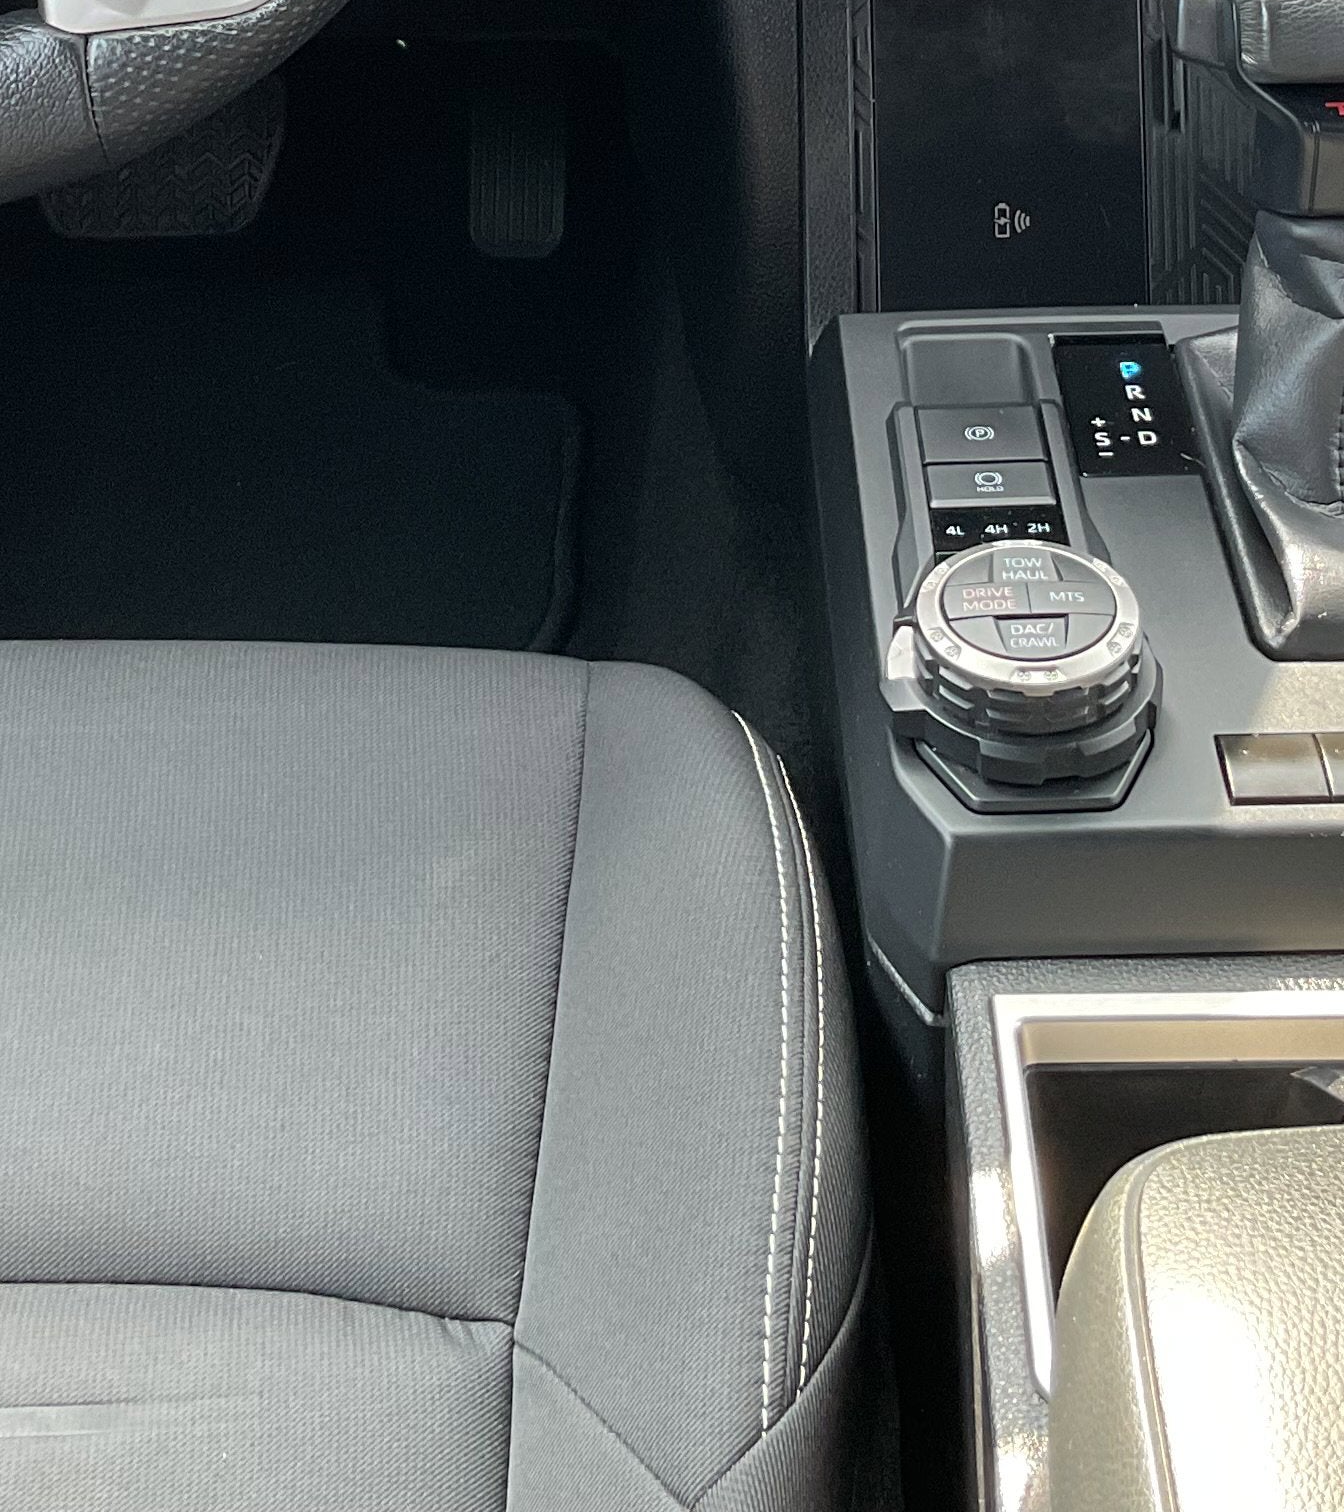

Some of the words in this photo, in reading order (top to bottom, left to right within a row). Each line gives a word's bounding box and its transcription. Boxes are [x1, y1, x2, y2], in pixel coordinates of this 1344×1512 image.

[1118, 360, 1142, 379] P
[1124, 384, 1146, 401] R
[1131, 407, 1153, 422] N
[1093, 431, 1111, 447] S
[1137, 430, 1157, 446] D
[945, 525, 966, 536] 4L
[984, 523, 1008, 535] 4H
[1026, 522, 1051, 534] 2H
[1003, 557, 1043, 569] TOW
[1001, 569, 1049, 581] HAUL
[962, 586, 1016, 600] DRIVE
[1049, 591, 1085, 603] MTS
[962, 599, 1017, 612] MODE
[1010, 623, 1054, 636] DAC/
[1010, 637, 1060, 649] CRAWL
